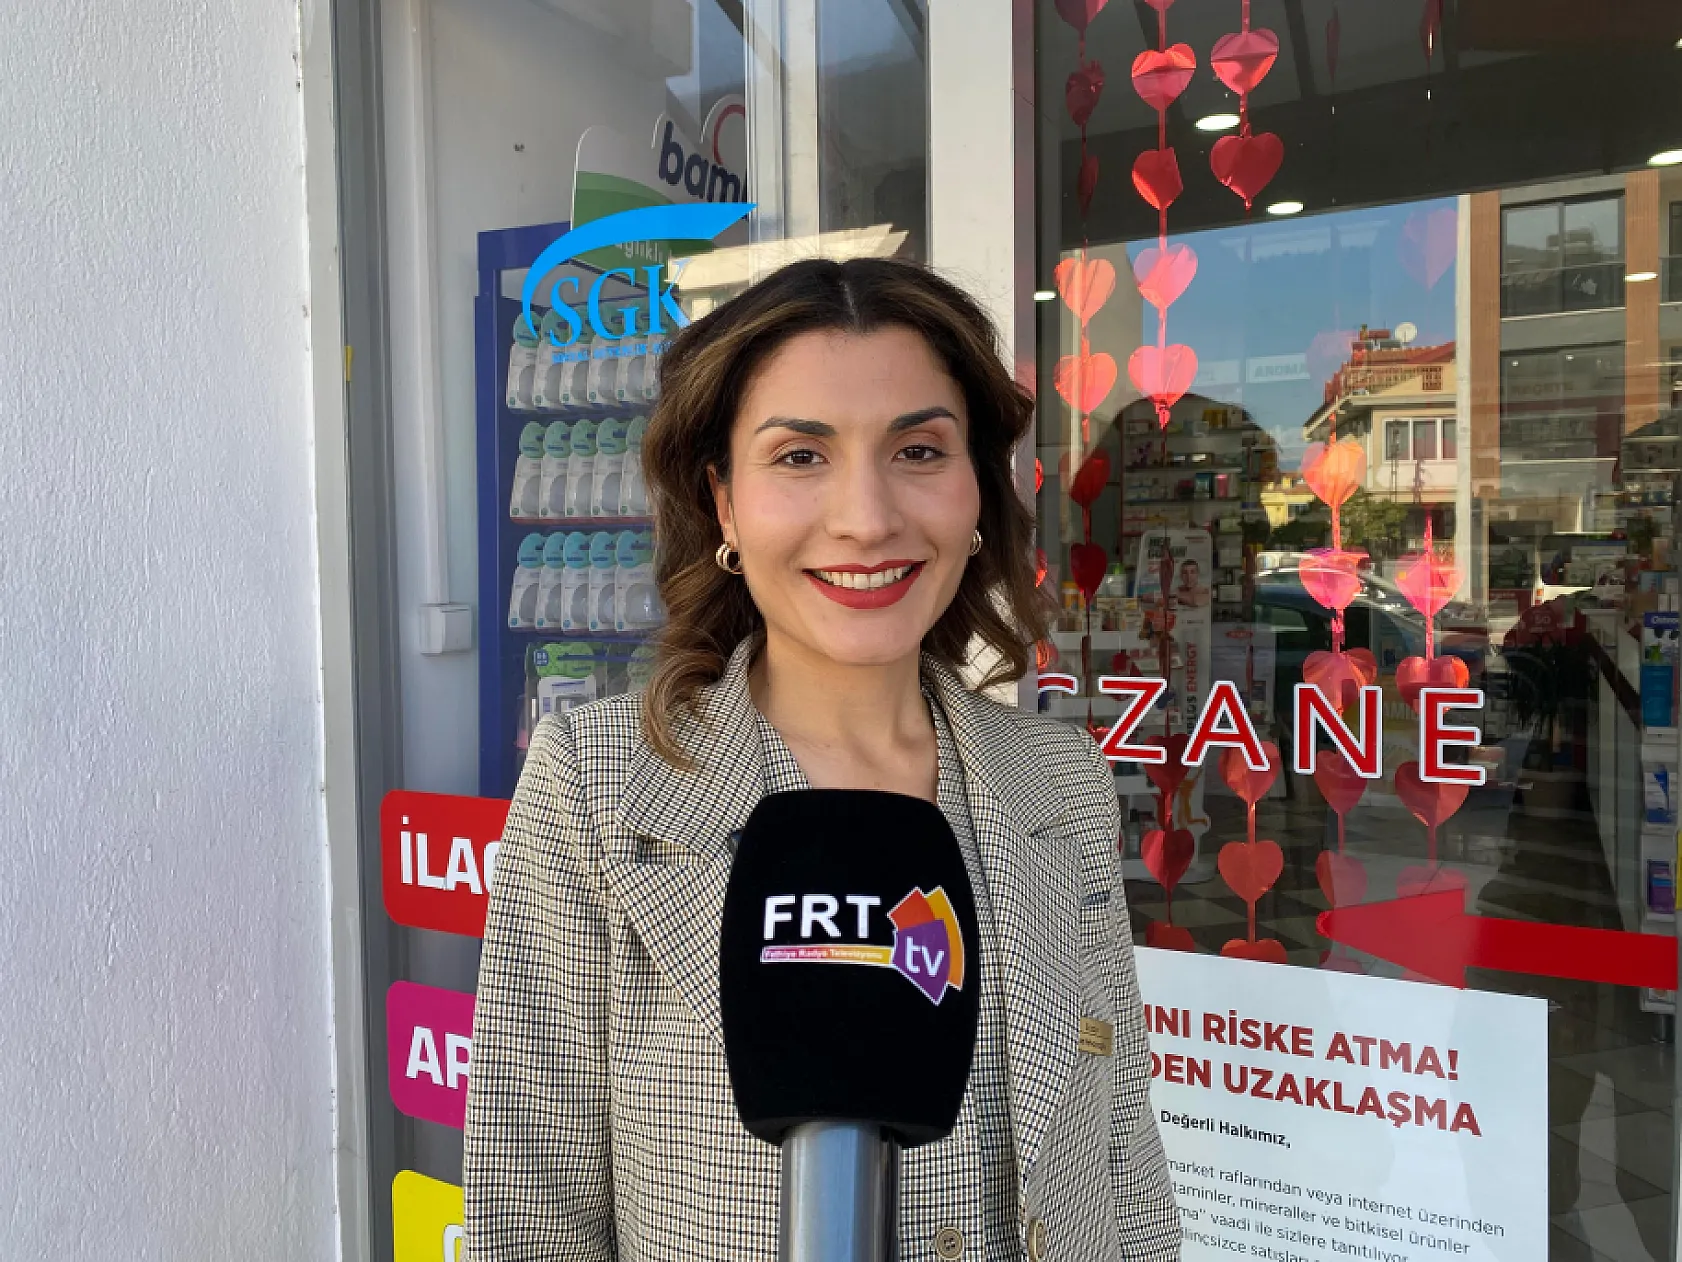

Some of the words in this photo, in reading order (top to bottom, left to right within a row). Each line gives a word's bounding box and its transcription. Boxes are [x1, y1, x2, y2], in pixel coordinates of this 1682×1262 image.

[658, 121, 747, 203] bam
[550, 258, 691, 347] SGK
[763, 894, 881, 940] FRT
[906, 936, 944, 977] tv
[1203, 1009, 1314, 1058] RİSKE
[1325, 1032, 1459, 1080] ATMA!
[1160, 1110, 1214, 1131] Değerli
[1220, 1120, 1291, 1149] Halkımız,
[1224, 1063, 1482, 1137] UZAKLAŞMA
[1210, 1214, 1250, 1231] vaadi
[1255, 1222, 1272, 1236] ile
[1277, 1226, 1327, 1249] sizlere
[1219, 1170, 1302, 1196] raflarından
[1306, 1188, 1342, 1206] veya
[1348, 1194, 1413, 1220] internet
[1418, 1208, 1504, 1237] üzerinden
[1240, 1197, 1316, 1222] mineraller
[1321, 1214, 1340, 1227] ve
[1345, 1216, 1403, 1241] bitkisel
[1409, 1231, 1471, 1255] ürünler
